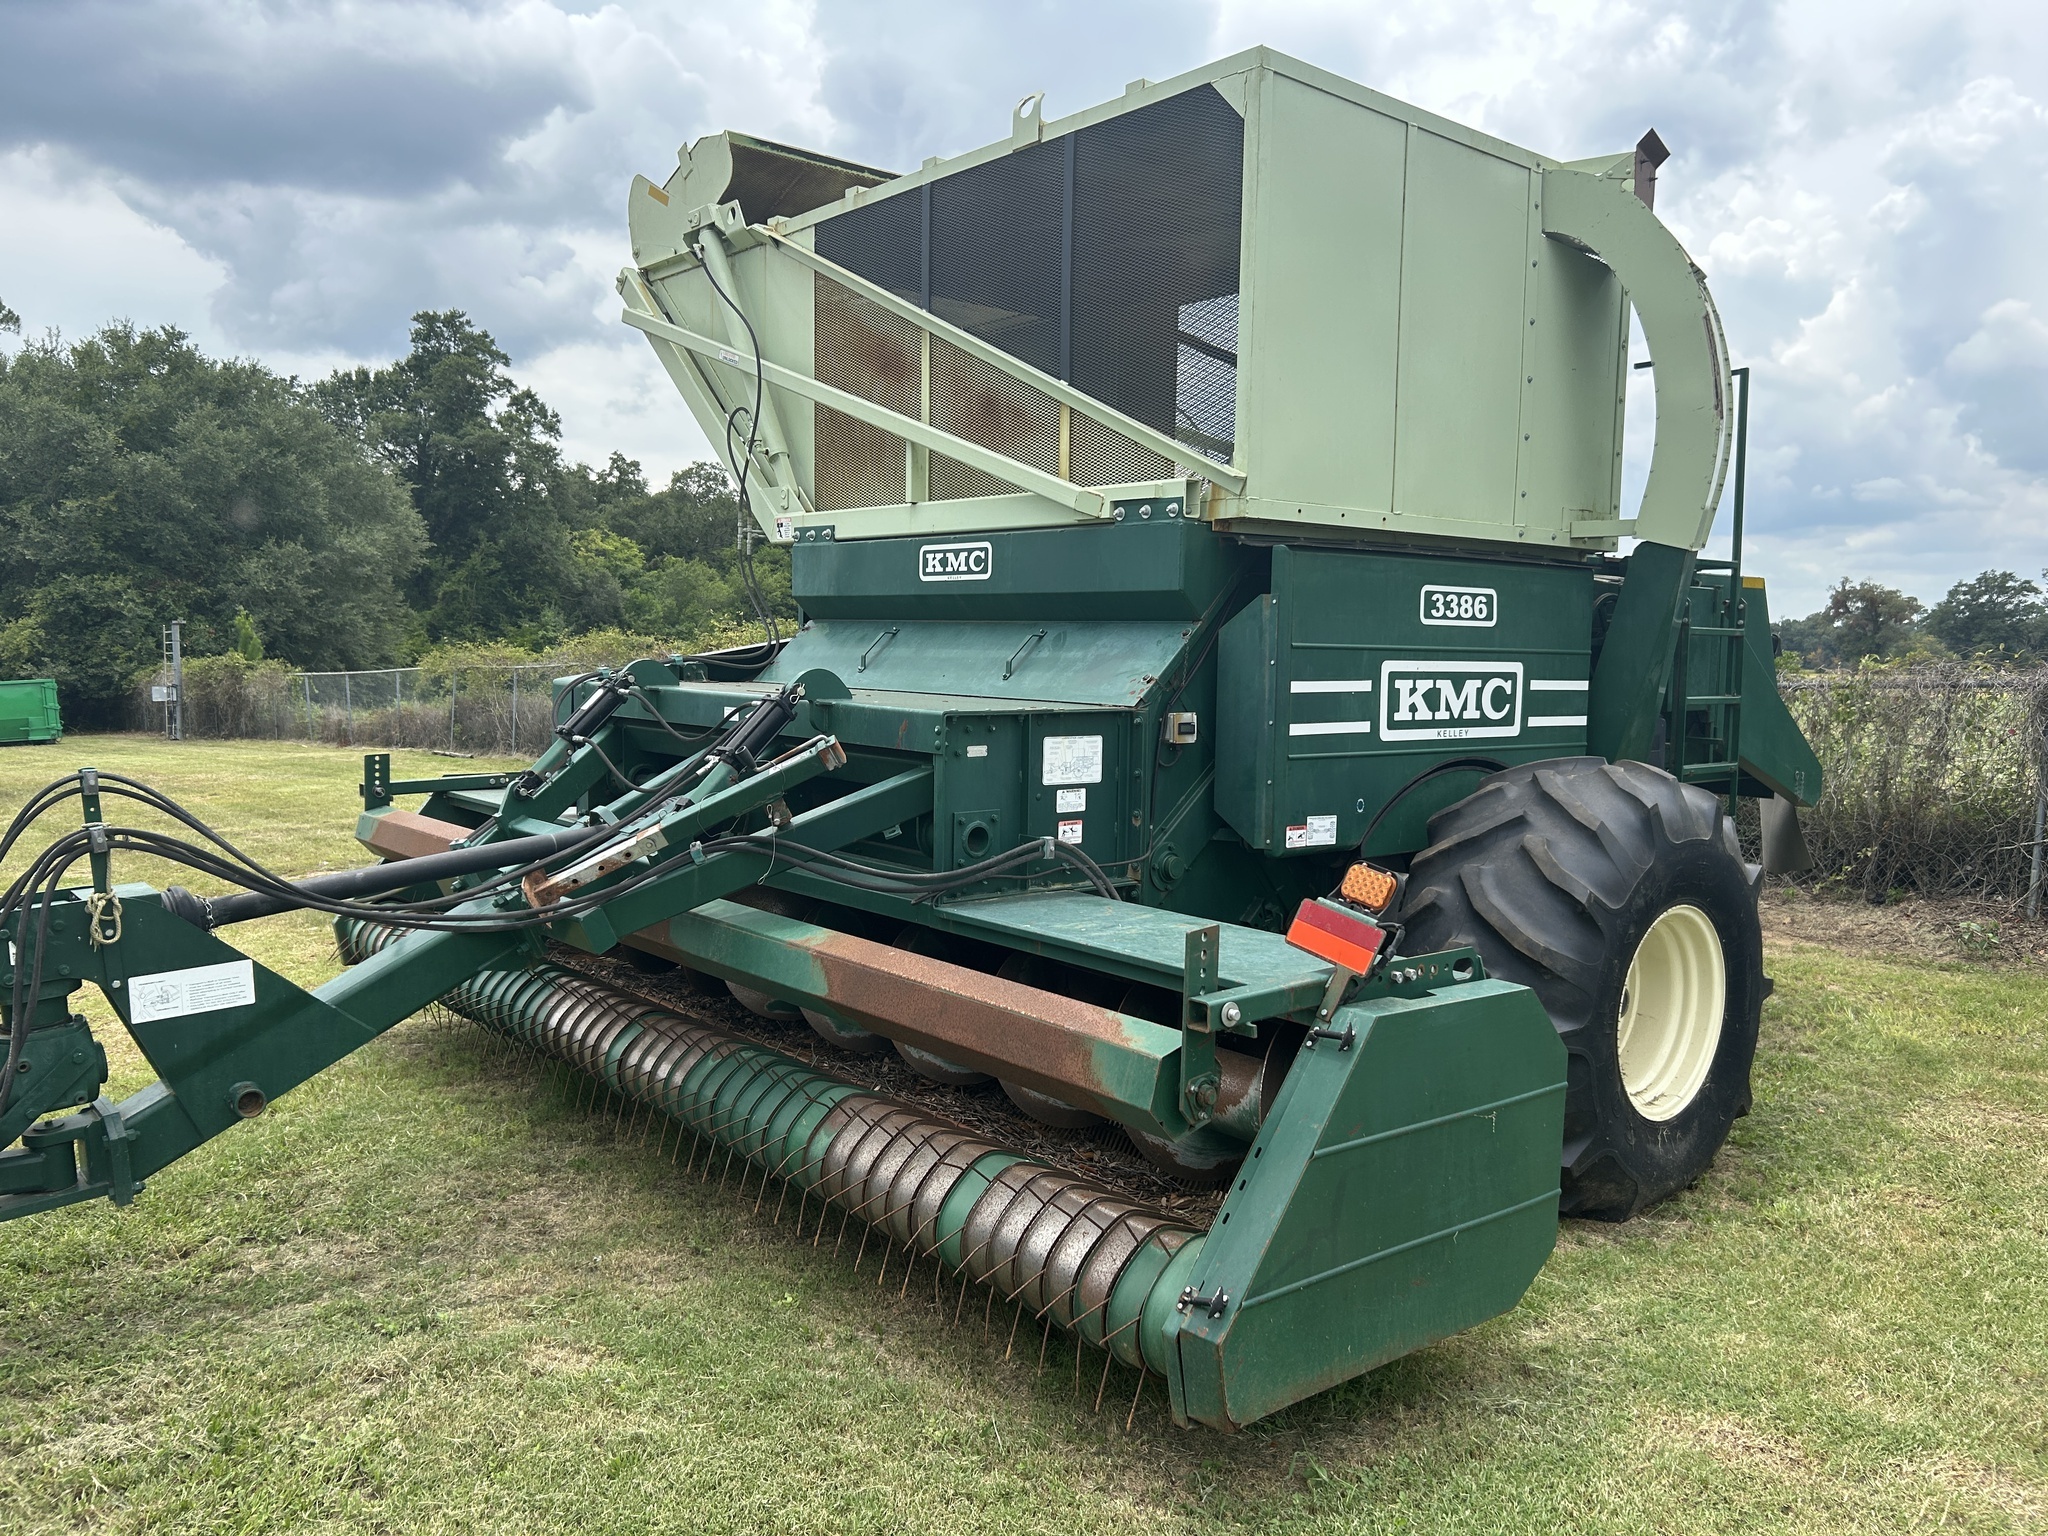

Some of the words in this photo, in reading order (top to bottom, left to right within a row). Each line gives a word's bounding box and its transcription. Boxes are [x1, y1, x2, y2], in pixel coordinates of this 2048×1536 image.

[926, 550, 985, 573] KMC
[1431, 593, 1487, 619] 3386
[1394, 678, 1512, 721] KMC
[1436, 729, 1469, 738] KELLEY
